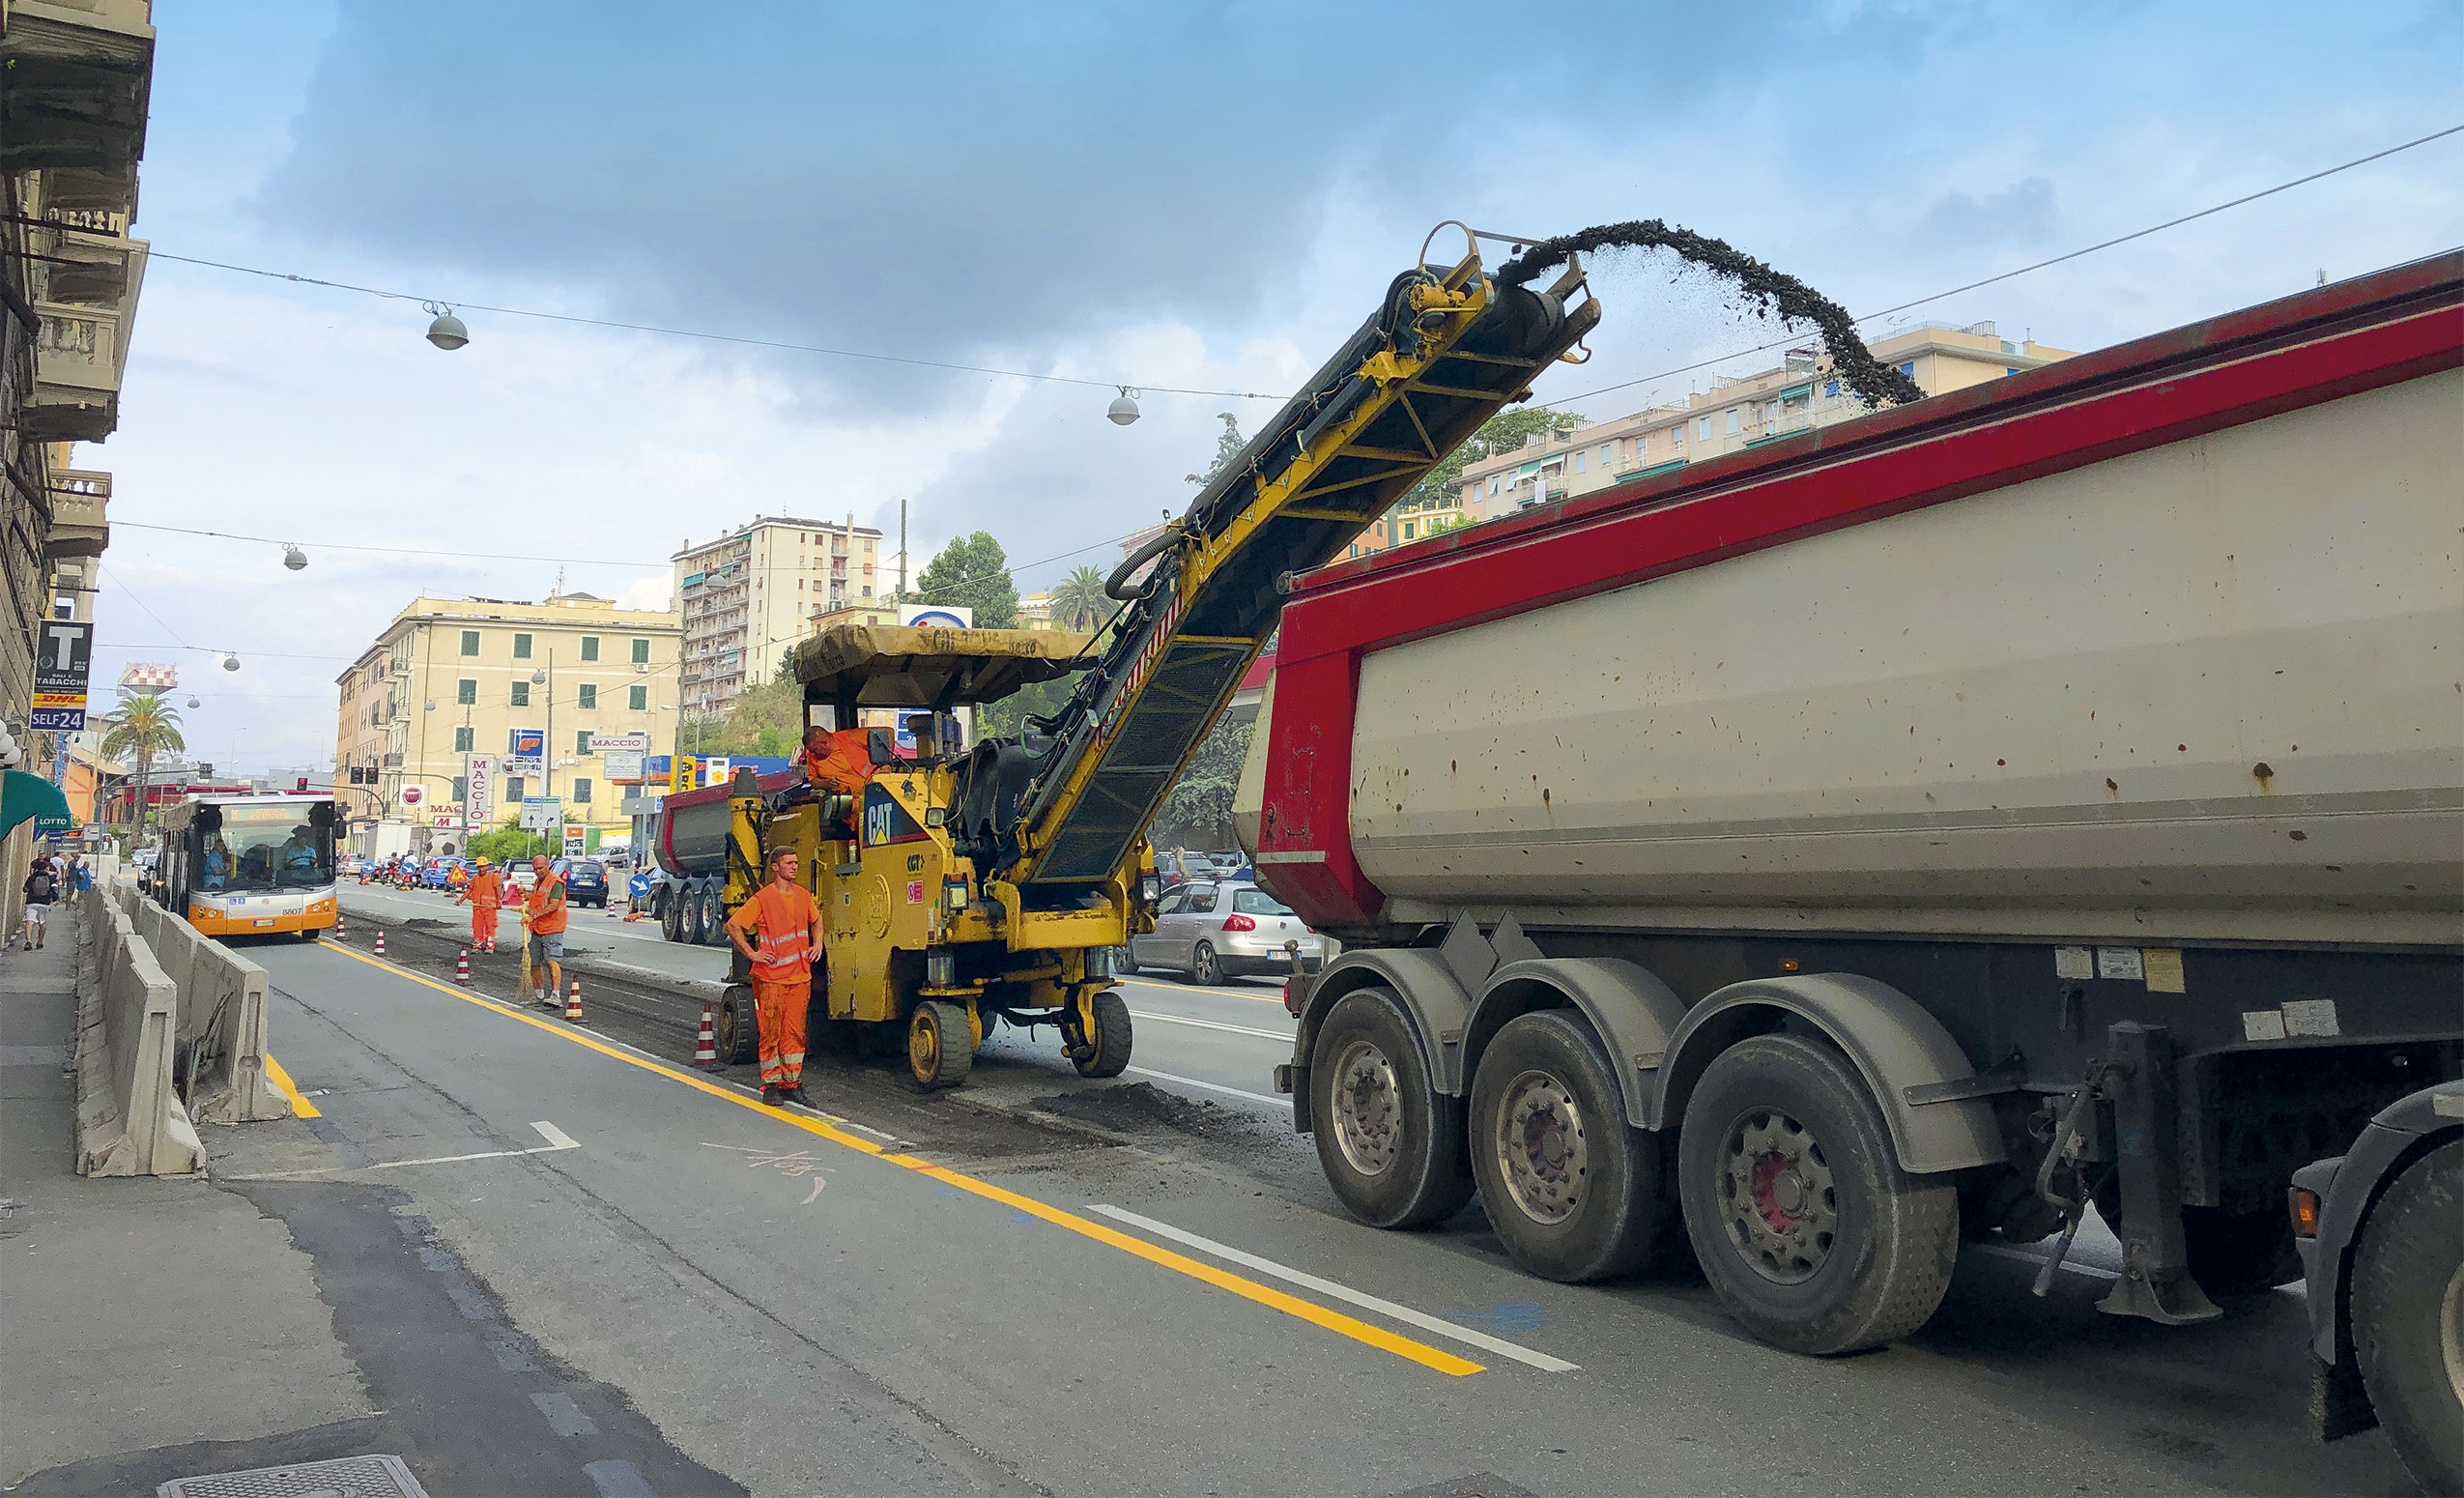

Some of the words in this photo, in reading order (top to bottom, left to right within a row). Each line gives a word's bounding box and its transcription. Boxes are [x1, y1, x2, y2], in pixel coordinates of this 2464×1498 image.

[48, 626, 84, 671] T
[36, 677, 88, 686] TABACCHI
[868, 802, 893, 846] CAT
